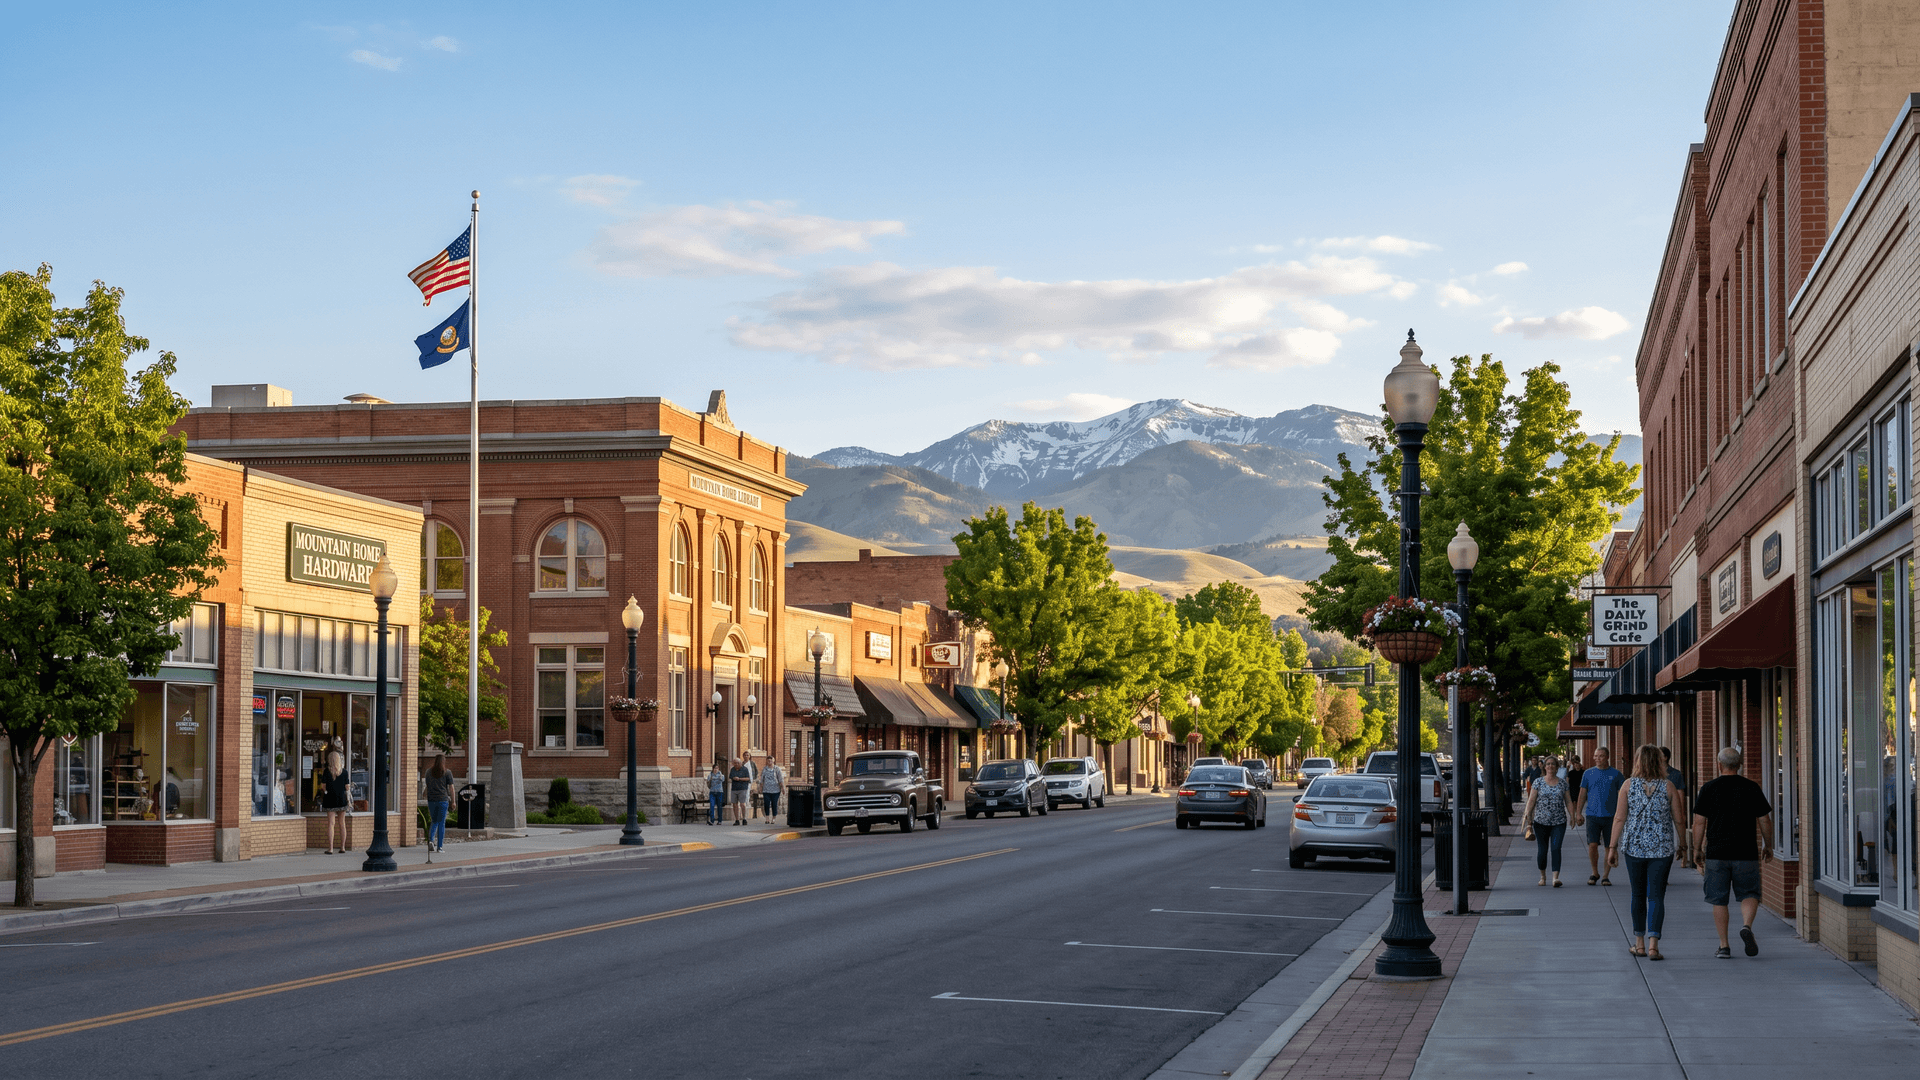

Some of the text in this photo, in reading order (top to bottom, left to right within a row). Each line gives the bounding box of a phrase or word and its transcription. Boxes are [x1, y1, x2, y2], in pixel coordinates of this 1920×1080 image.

[295, 531, 381, 563] MOUNTAIN HOME
[1612, 598, 1638, 608] The
[1605, 610, 1646, 619] DAILY
[1609, 632, 1641, 642] Cafe
